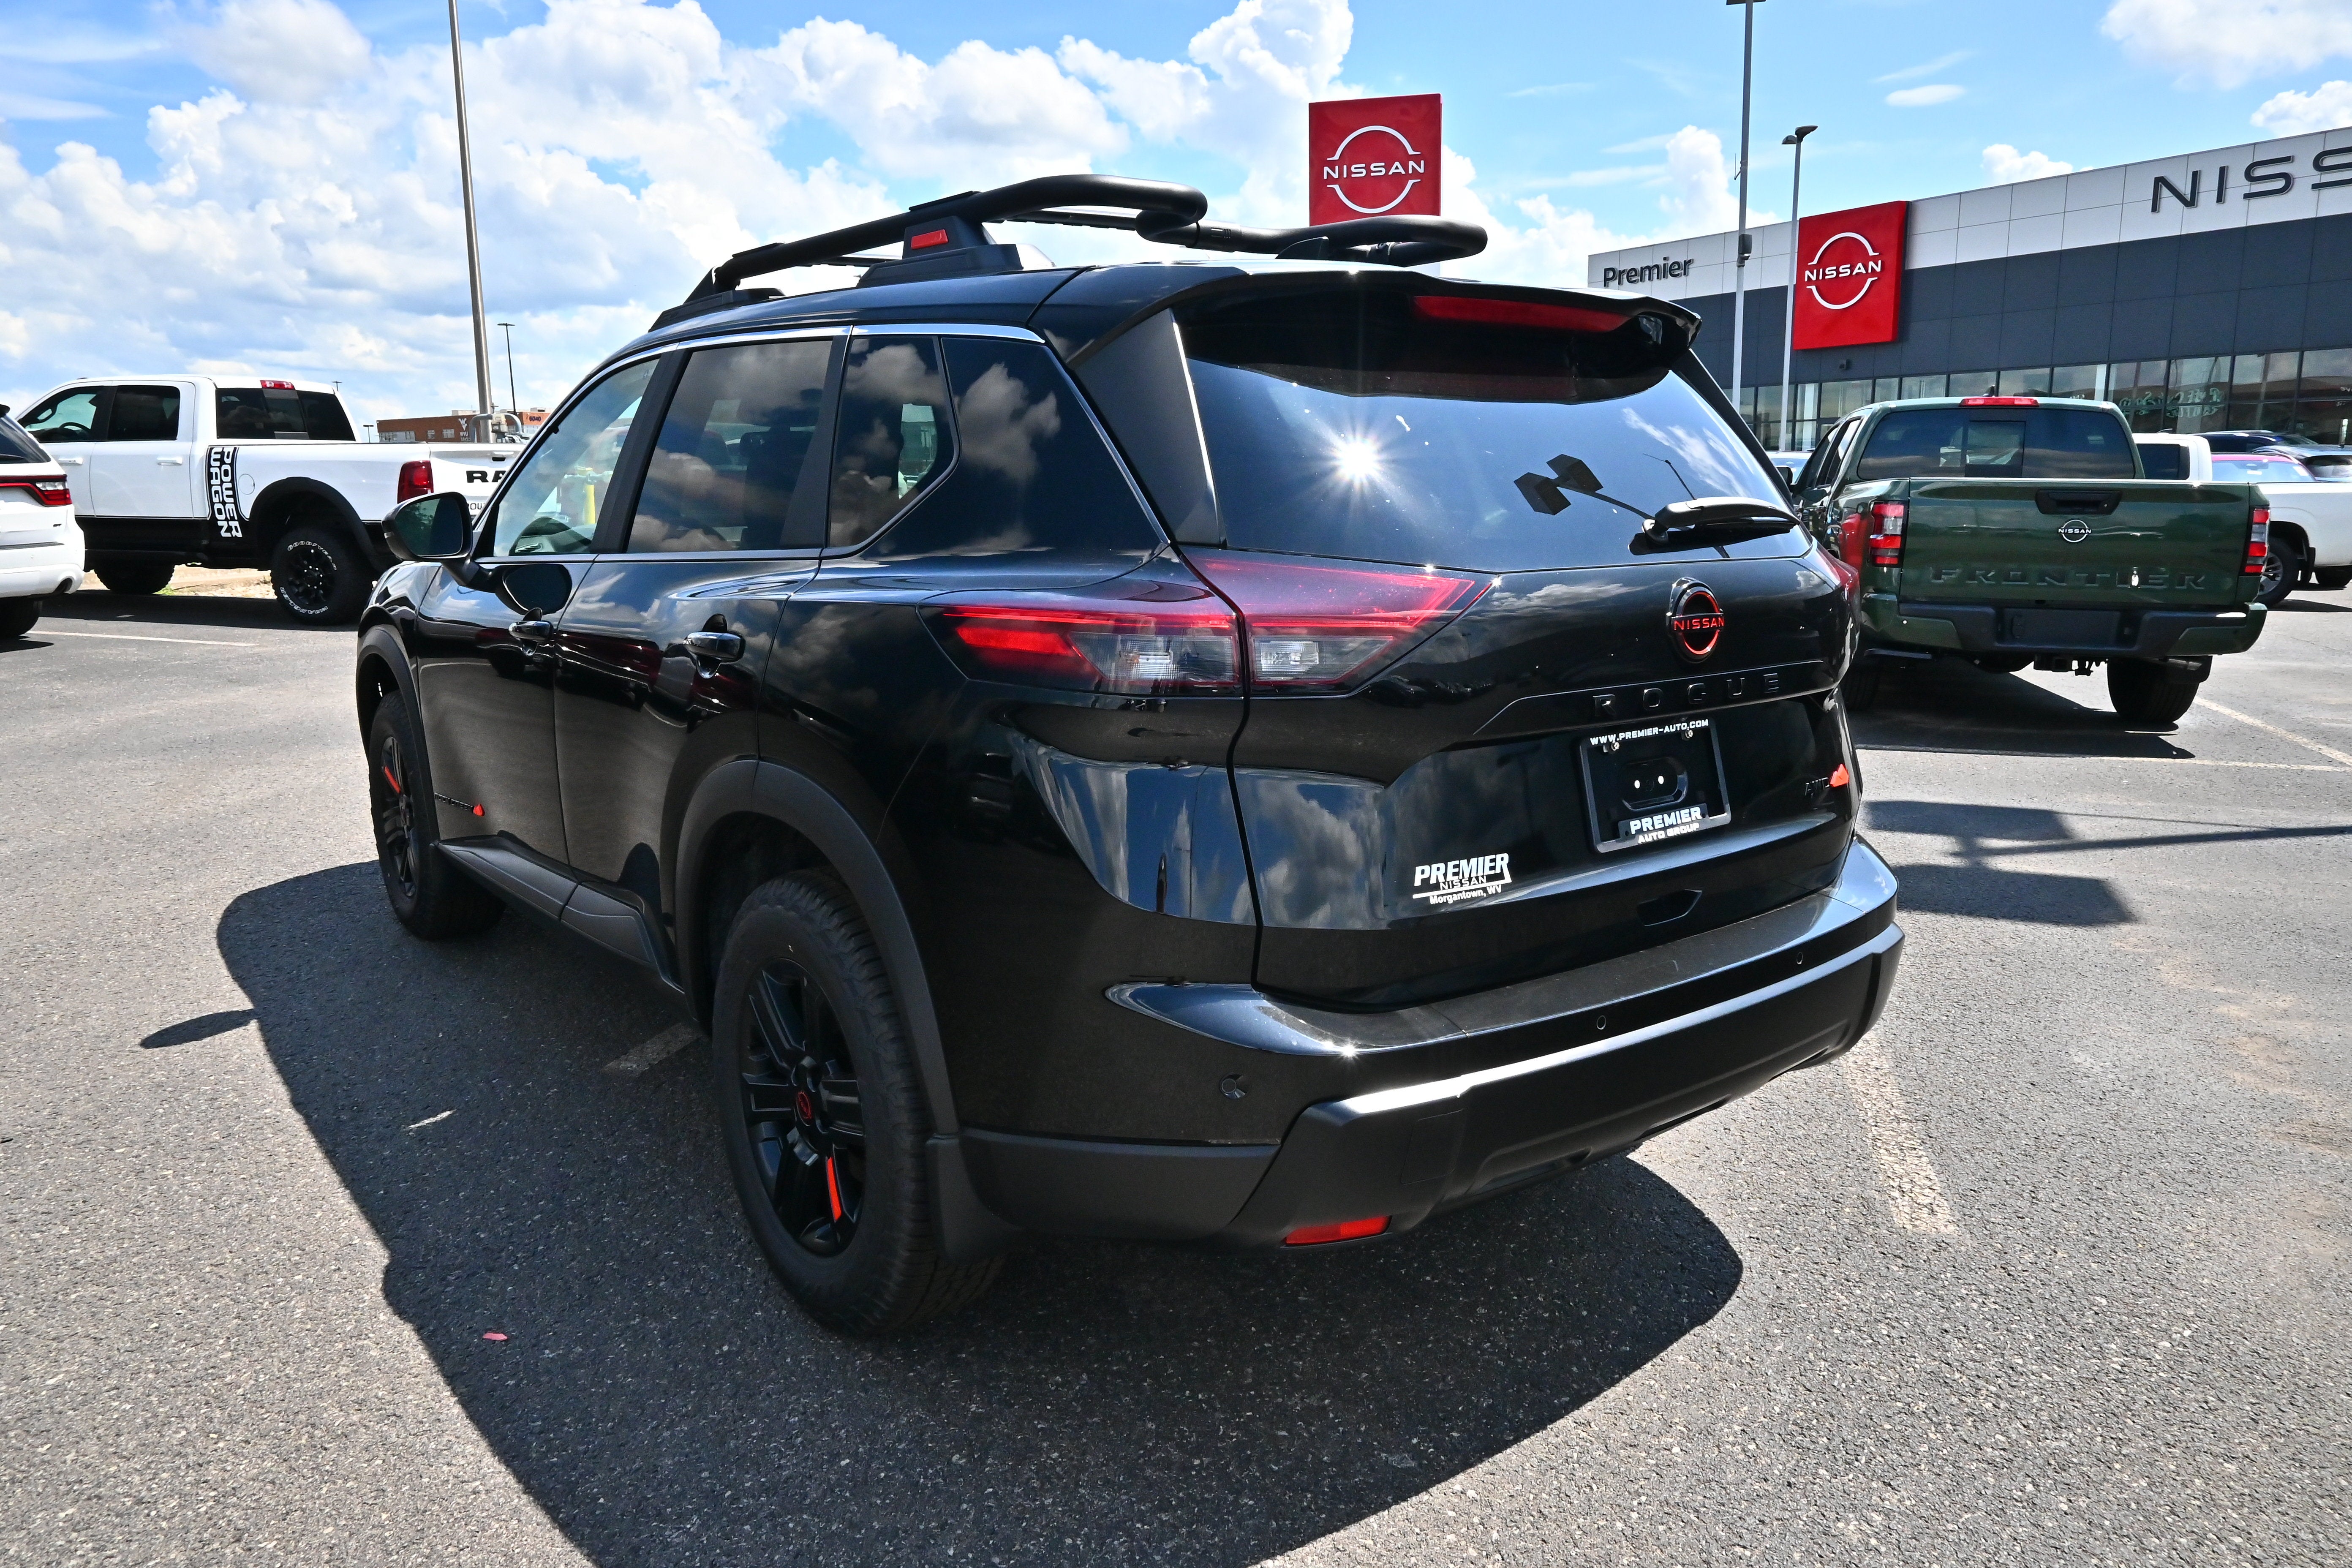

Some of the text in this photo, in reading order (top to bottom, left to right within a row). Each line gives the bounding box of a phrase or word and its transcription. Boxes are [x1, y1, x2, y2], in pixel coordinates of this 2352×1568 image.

[1323, 160, 1424, 180] NISSAN
[1603, 256, 1693, 288] Premier
[1805, 260, 1881, 282] NISSAN
[210, 447, 232, 537] WAGON
[221, 447, 242, 538] POWER
[1930, 566, 2205, 589] FRONTIER
[280, 587, 328, 614] WRANGLER
[1674, 617, 1724, 630] NISSAN
[1592, 673, 1780, 716] ROGUE
[1590, 719, 1709, 746] WWW.PREMIER-AUTO.COM
[1629, 806, 1702, 834] PREMIER
[1638, 822, 1700, 844] AUTO GROUP
[1414, 852, 1512, 887] PREMIER
[1440, 875, 1487, 890] NISSAN
[1429, 885, 1502, 904] Morgantown, WV
